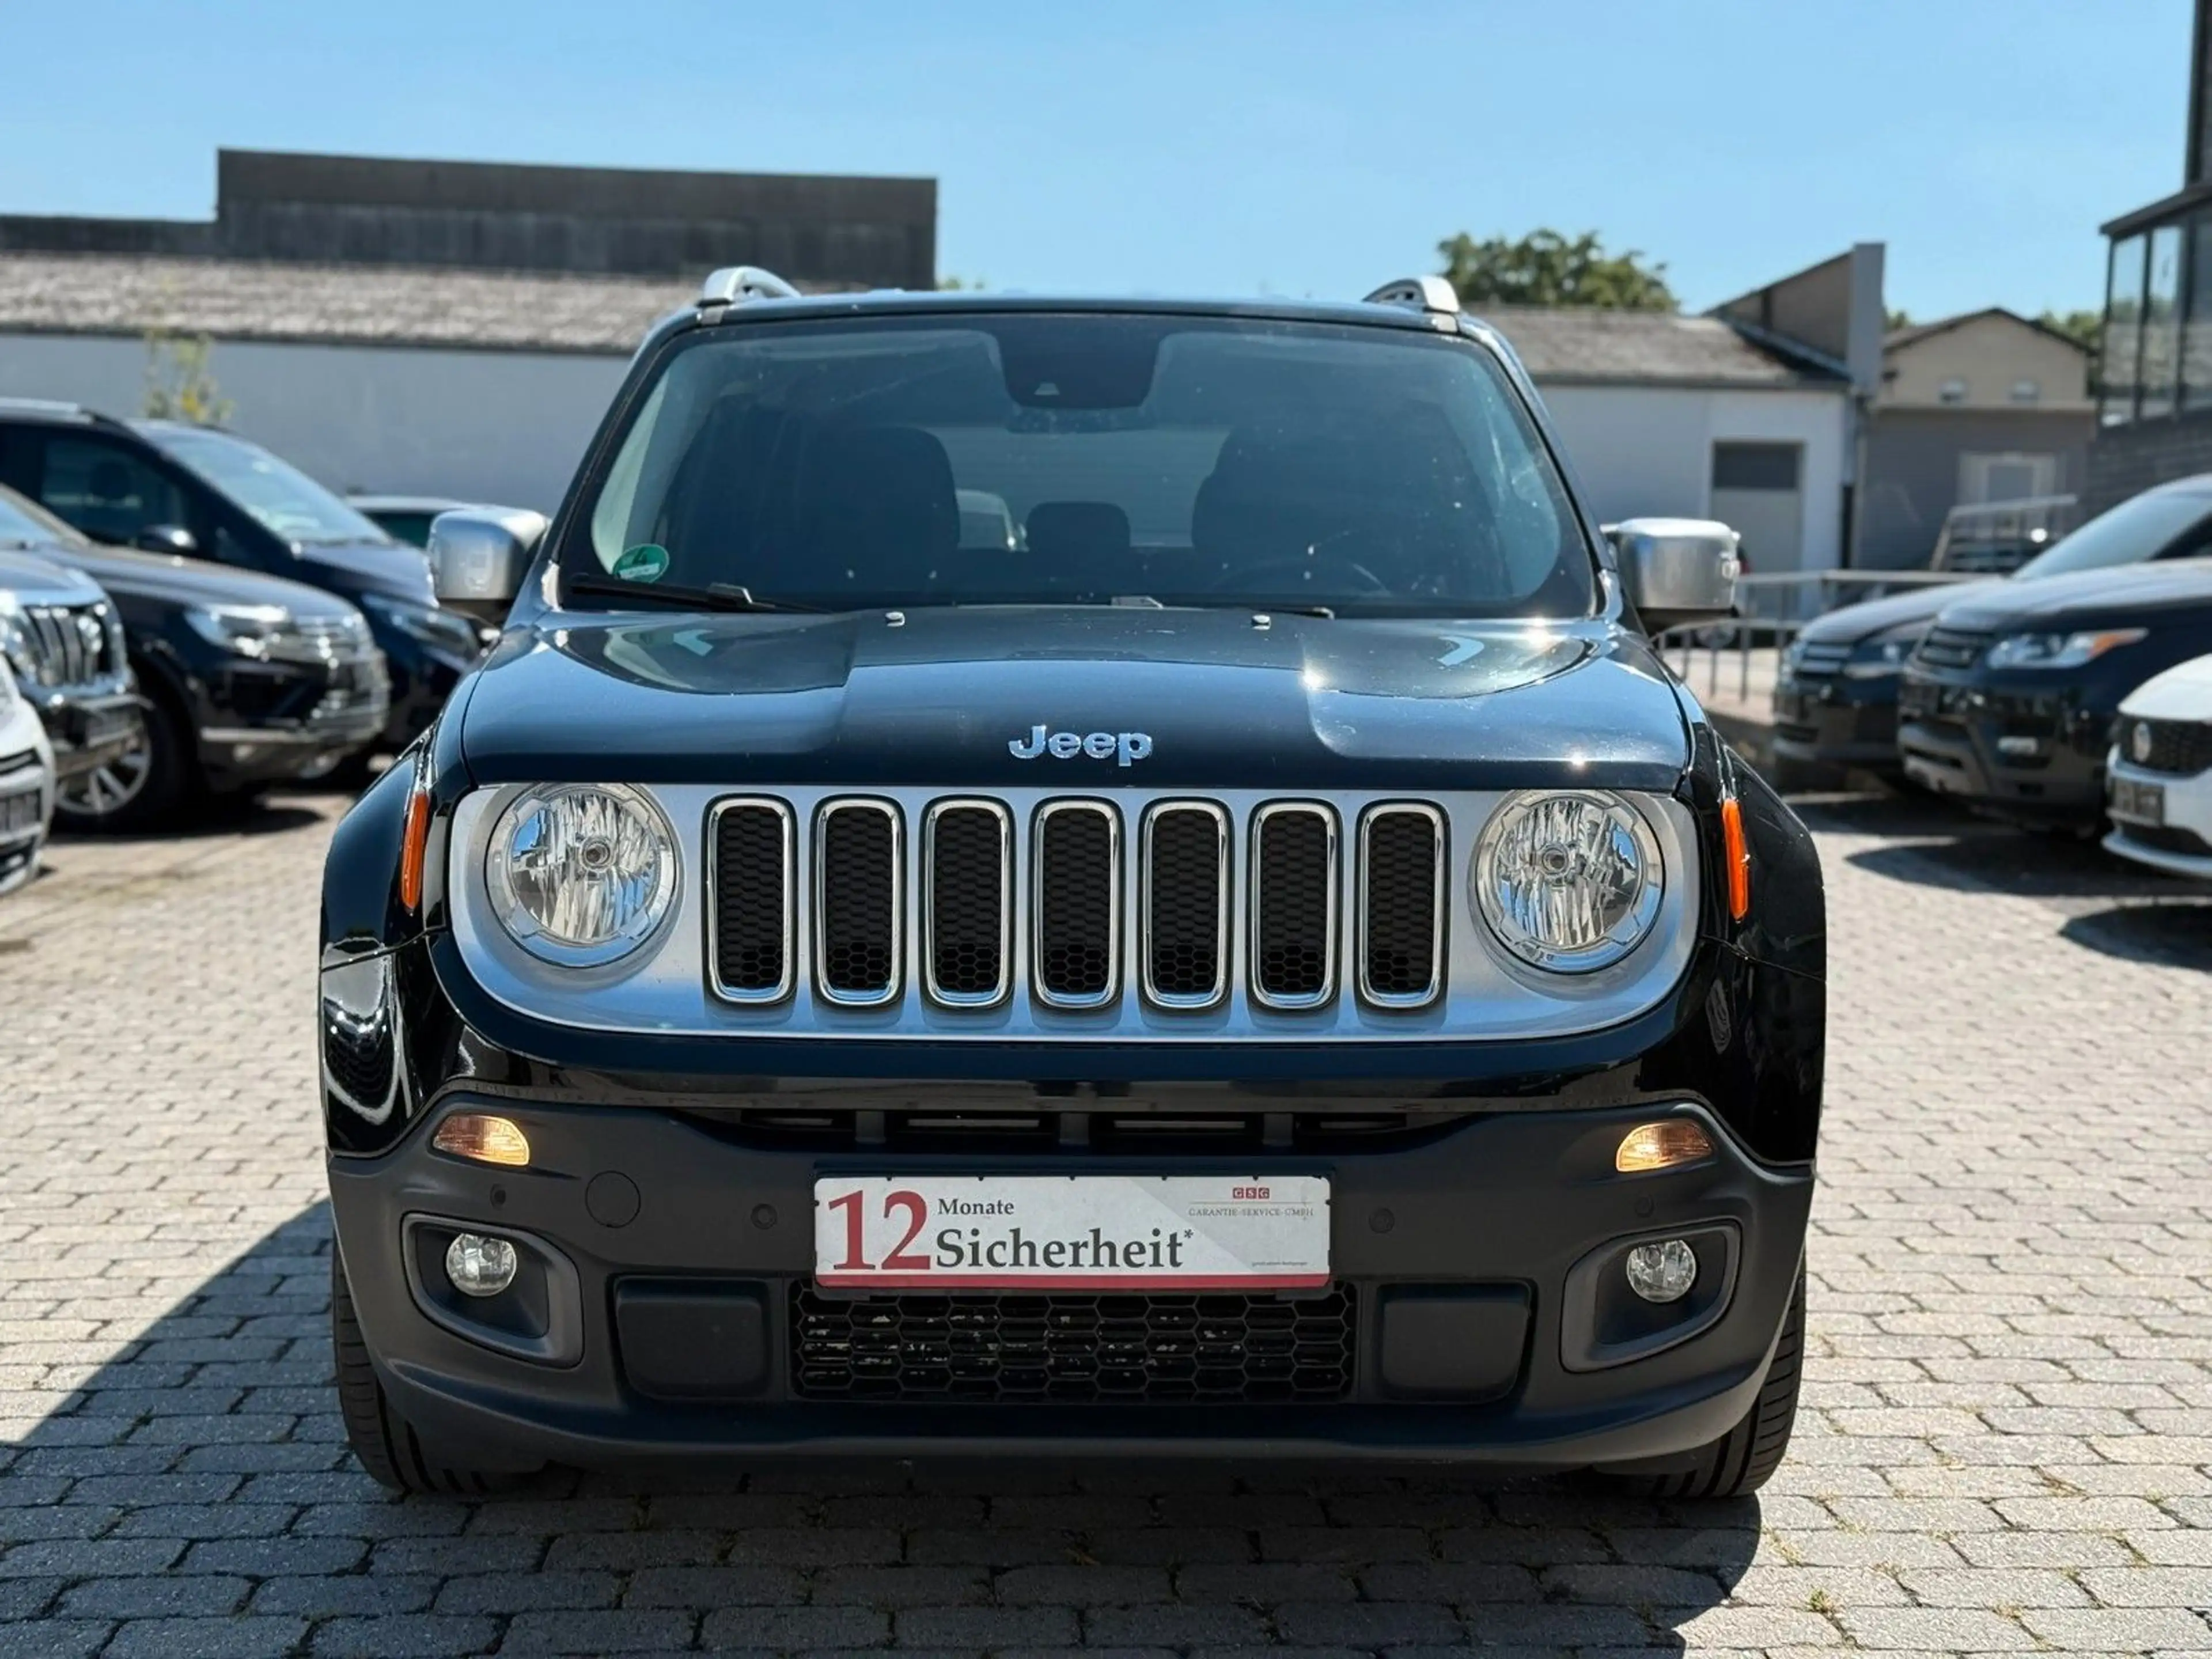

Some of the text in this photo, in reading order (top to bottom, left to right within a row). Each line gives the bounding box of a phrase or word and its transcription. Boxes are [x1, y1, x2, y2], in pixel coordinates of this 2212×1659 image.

[1008, 724, 1153, 767] Jeep
[937, 1198, 1014, 1215] Monate
[1233, 1187, 1270, 1199] GSG
[828, 1190, 930, 1270] 12
